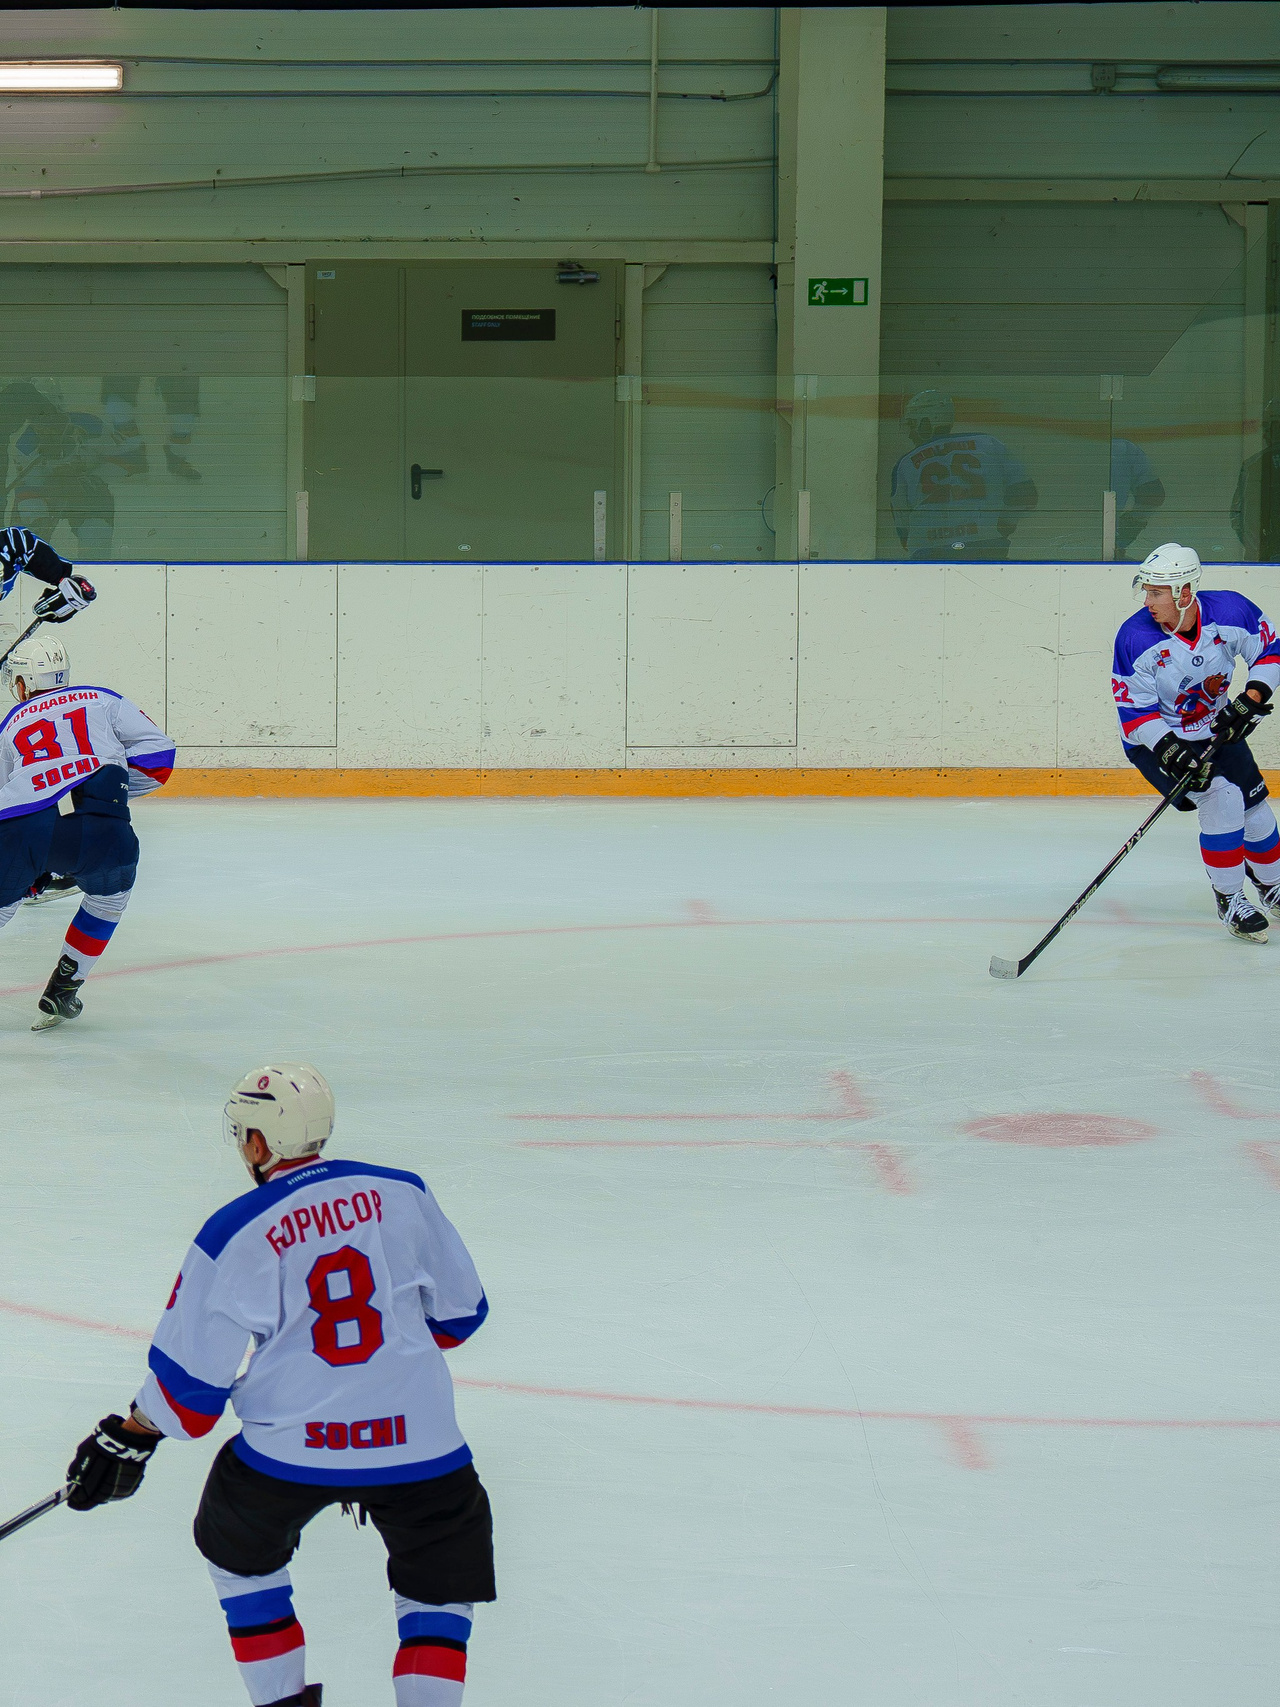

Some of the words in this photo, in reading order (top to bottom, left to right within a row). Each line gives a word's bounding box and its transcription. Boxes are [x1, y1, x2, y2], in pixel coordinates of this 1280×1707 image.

[54, 672, 64, 684] 12
[13, 706, 95, 767] 81
[31, 757, 101, 793] SOCHI
[305, 1244, 385, 1368] 8
[305, 1415, 407, 1450] SOCHI
